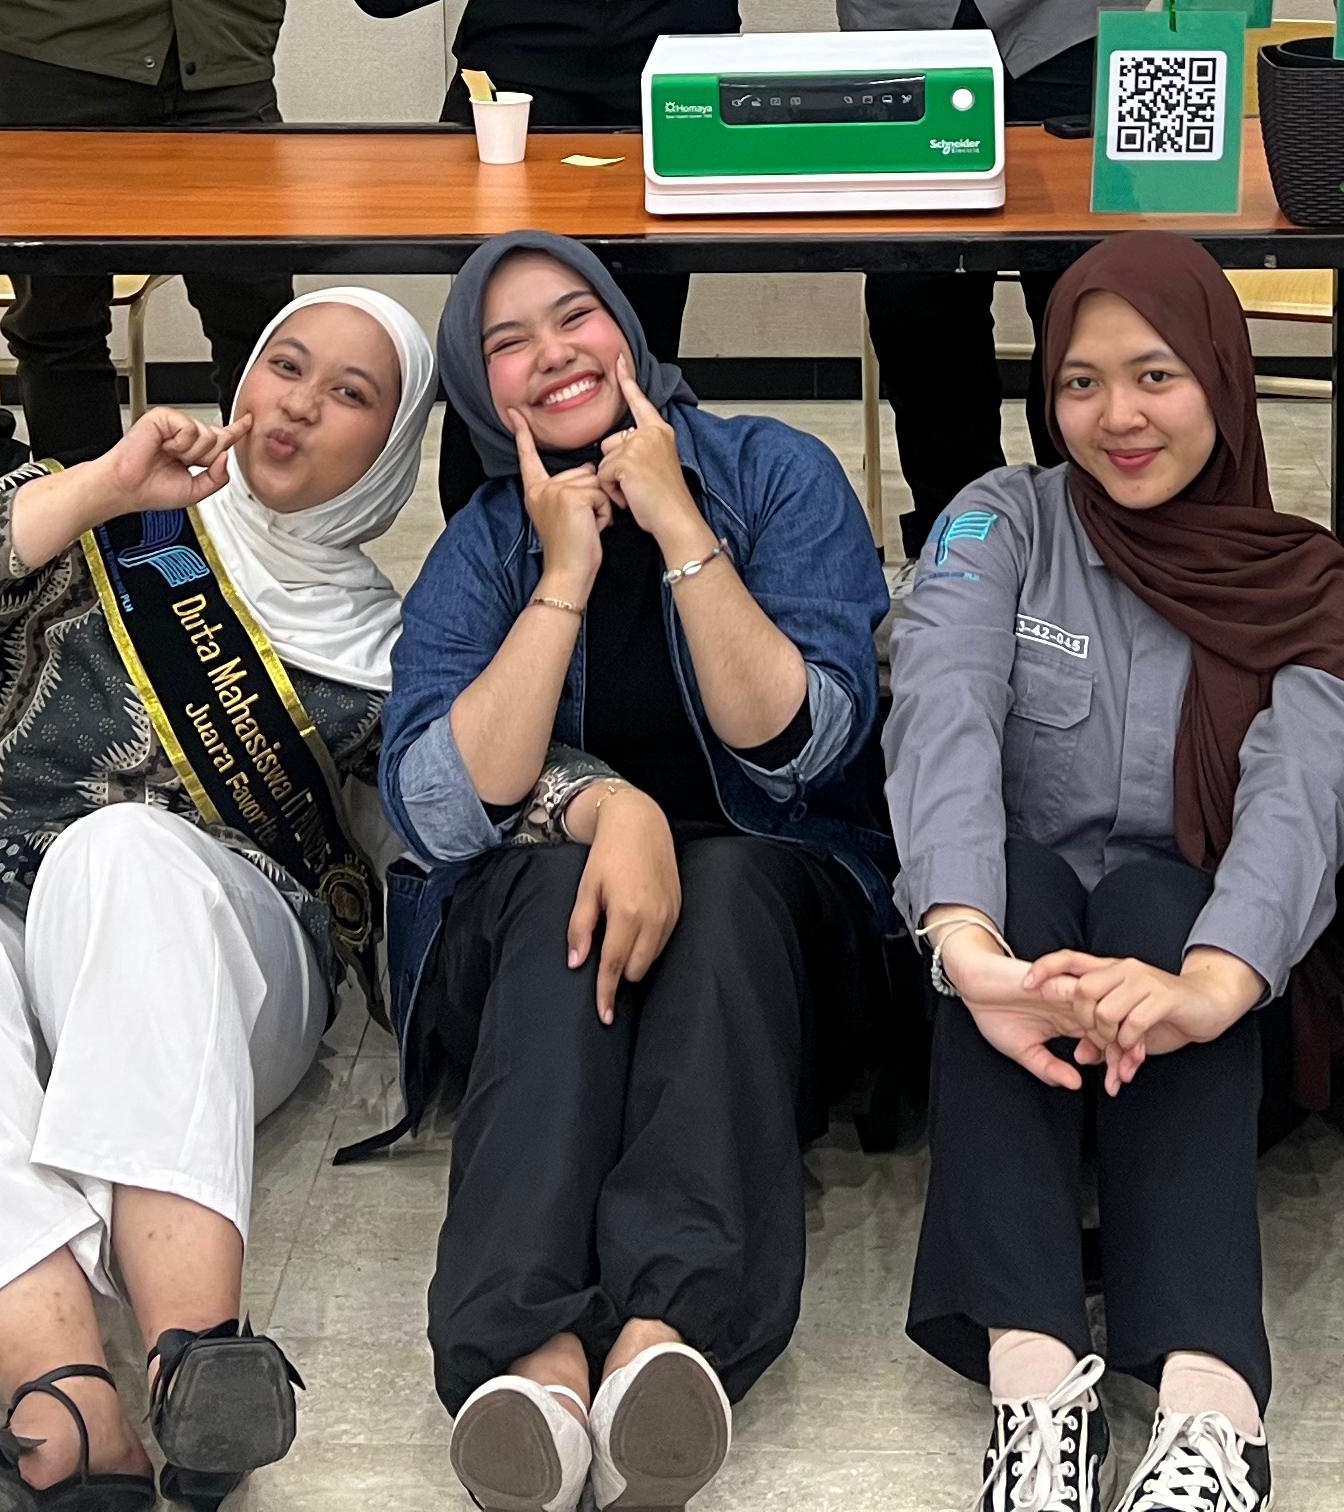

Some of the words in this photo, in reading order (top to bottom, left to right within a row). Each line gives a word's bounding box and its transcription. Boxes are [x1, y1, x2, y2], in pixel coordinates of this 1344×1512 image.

[171, 592, 223, 663] Duta
[207, 656, 294, 800] Mahasiswa
[184, 701, 235, 773] Juara
